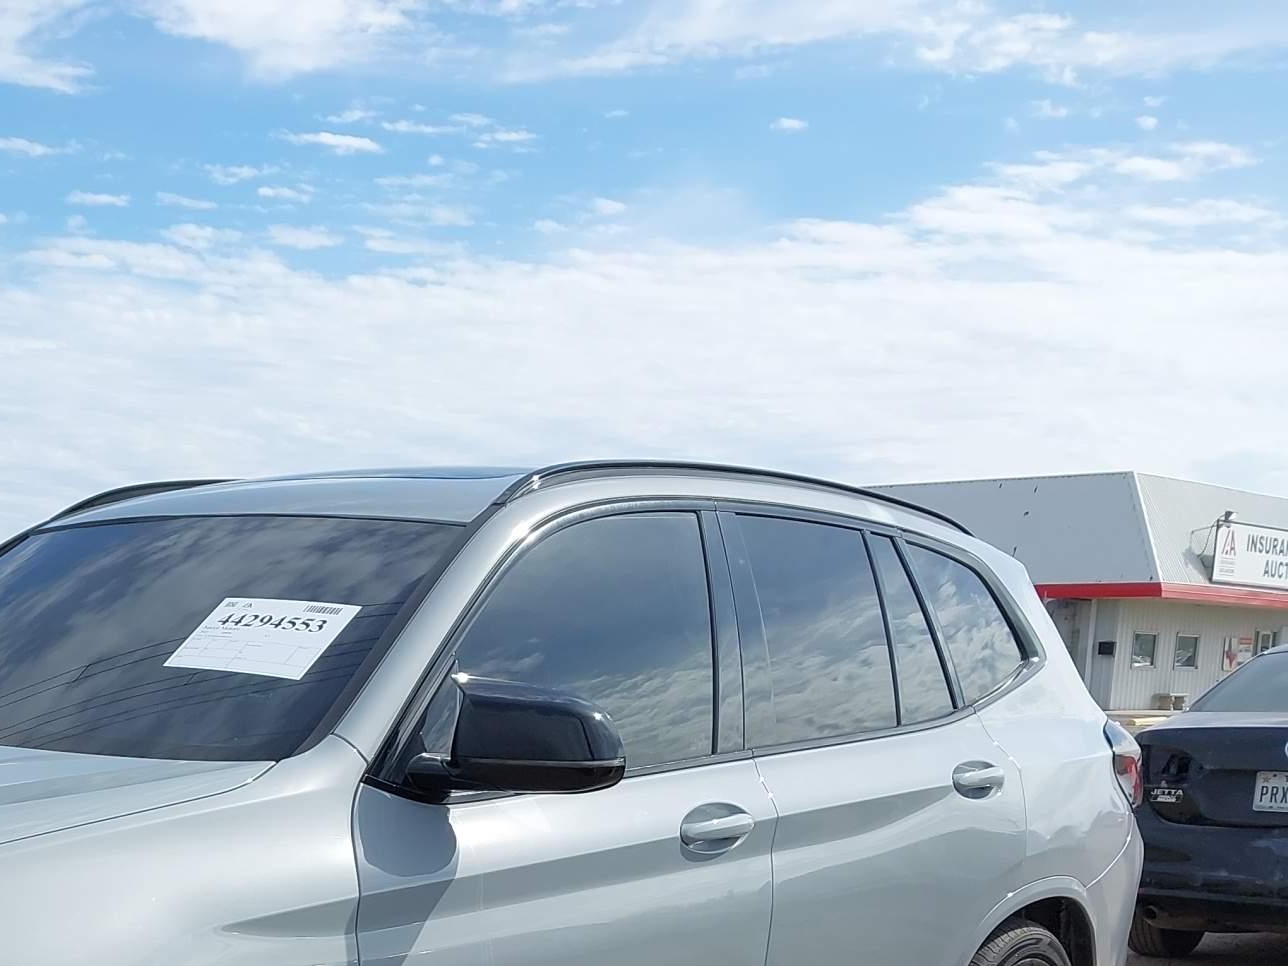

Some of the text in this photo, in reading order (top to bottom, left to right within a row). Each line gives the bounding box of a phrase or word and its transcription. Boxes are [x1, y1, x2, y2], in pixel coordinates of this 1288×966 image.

[1246, 534, 1288, 556] INSURA
[217, 613, 328, 633] 44294553
[1150, 788, 1184, 796] JETTA
